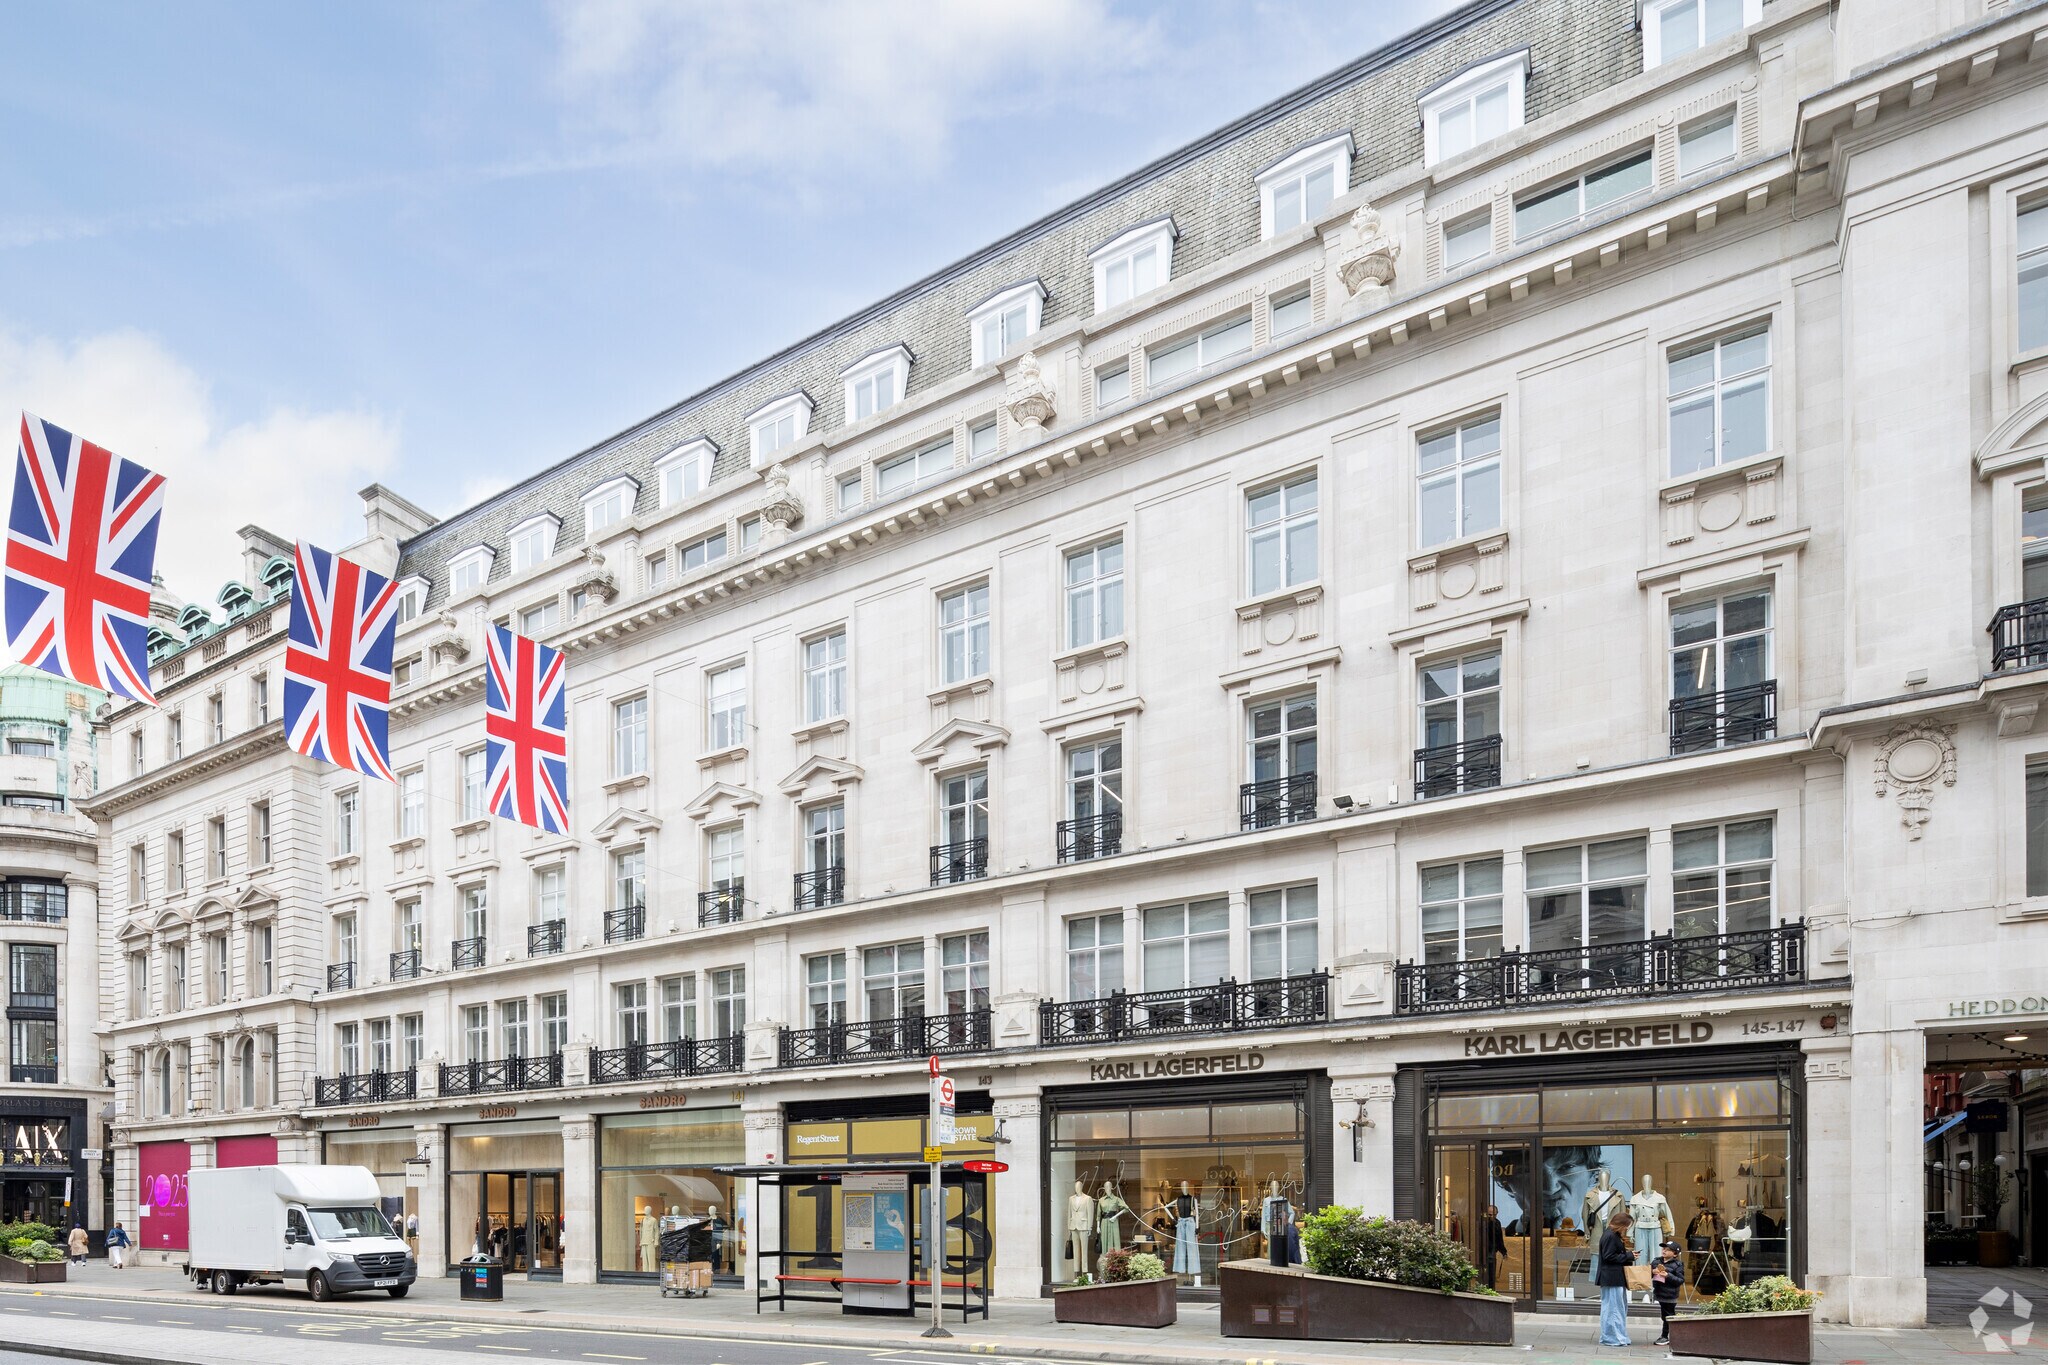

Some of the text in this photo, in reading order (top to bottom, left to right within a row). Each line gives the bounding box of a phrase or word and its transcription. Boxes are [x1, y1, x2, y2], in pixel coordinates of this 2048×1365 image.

[1742, 1019, 1806, 1036] 145-147
[1465, 1022, 1713, 1057] KARL LAGERFELD
[933, 1057, 939, 1072] L
[1091, 1053, 1265, 1081] KARL LAGERFELD
[978, 1075, 993, 1086] 143
[639, 1094, 687, 1109] SANDRO
[730, 1090, 745, 1102] 141
[478, 1106, 517, 1119] SANDRO
[348, 1116, 380, 1127] SANDRO
